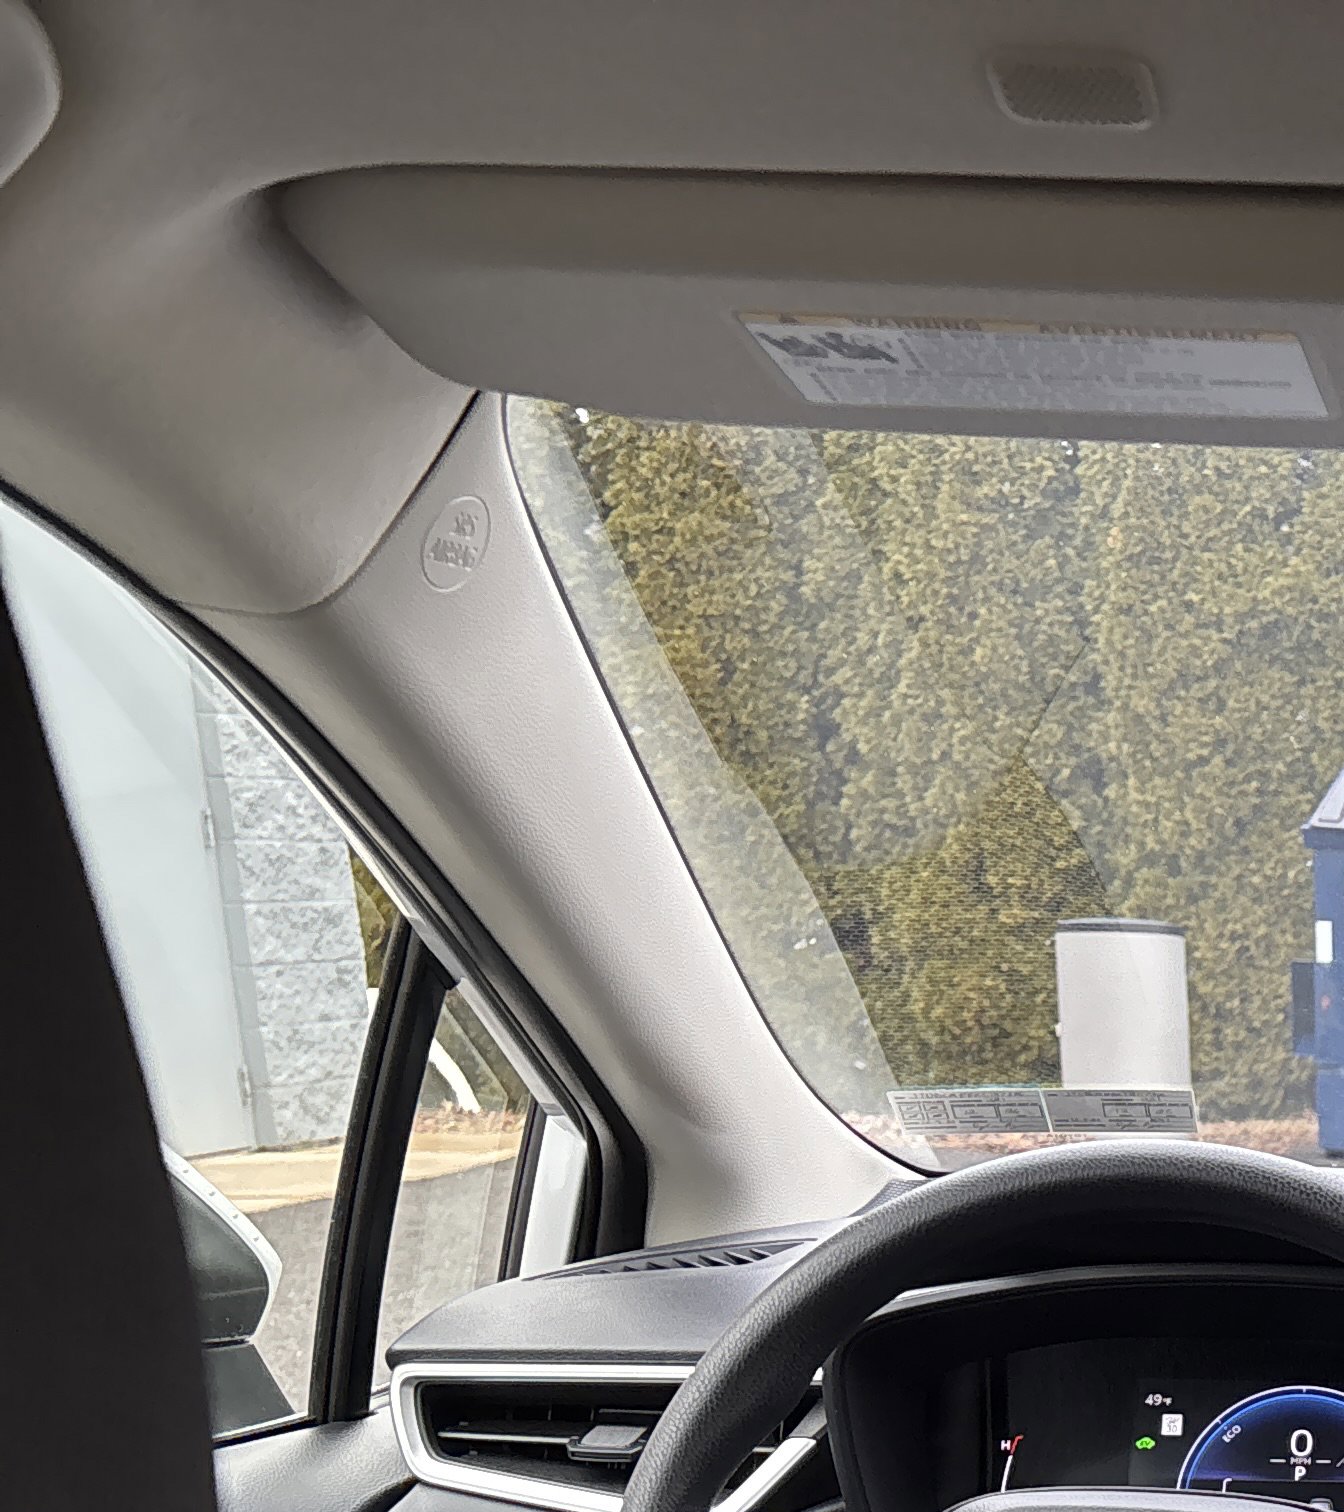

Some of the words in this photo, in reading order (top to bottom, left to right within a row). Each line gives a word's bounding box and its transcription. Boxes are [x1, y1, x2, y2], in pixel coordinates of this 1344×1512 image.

[1221, 1425, 1242, 1443] ECO
[1001, 1440, 1011, 1450] H
[1290, 1429, 1313, 1456] 0
[1290, 1457, 1312, 1465] MPH
[1294, 1465, 1306, 1481] P
